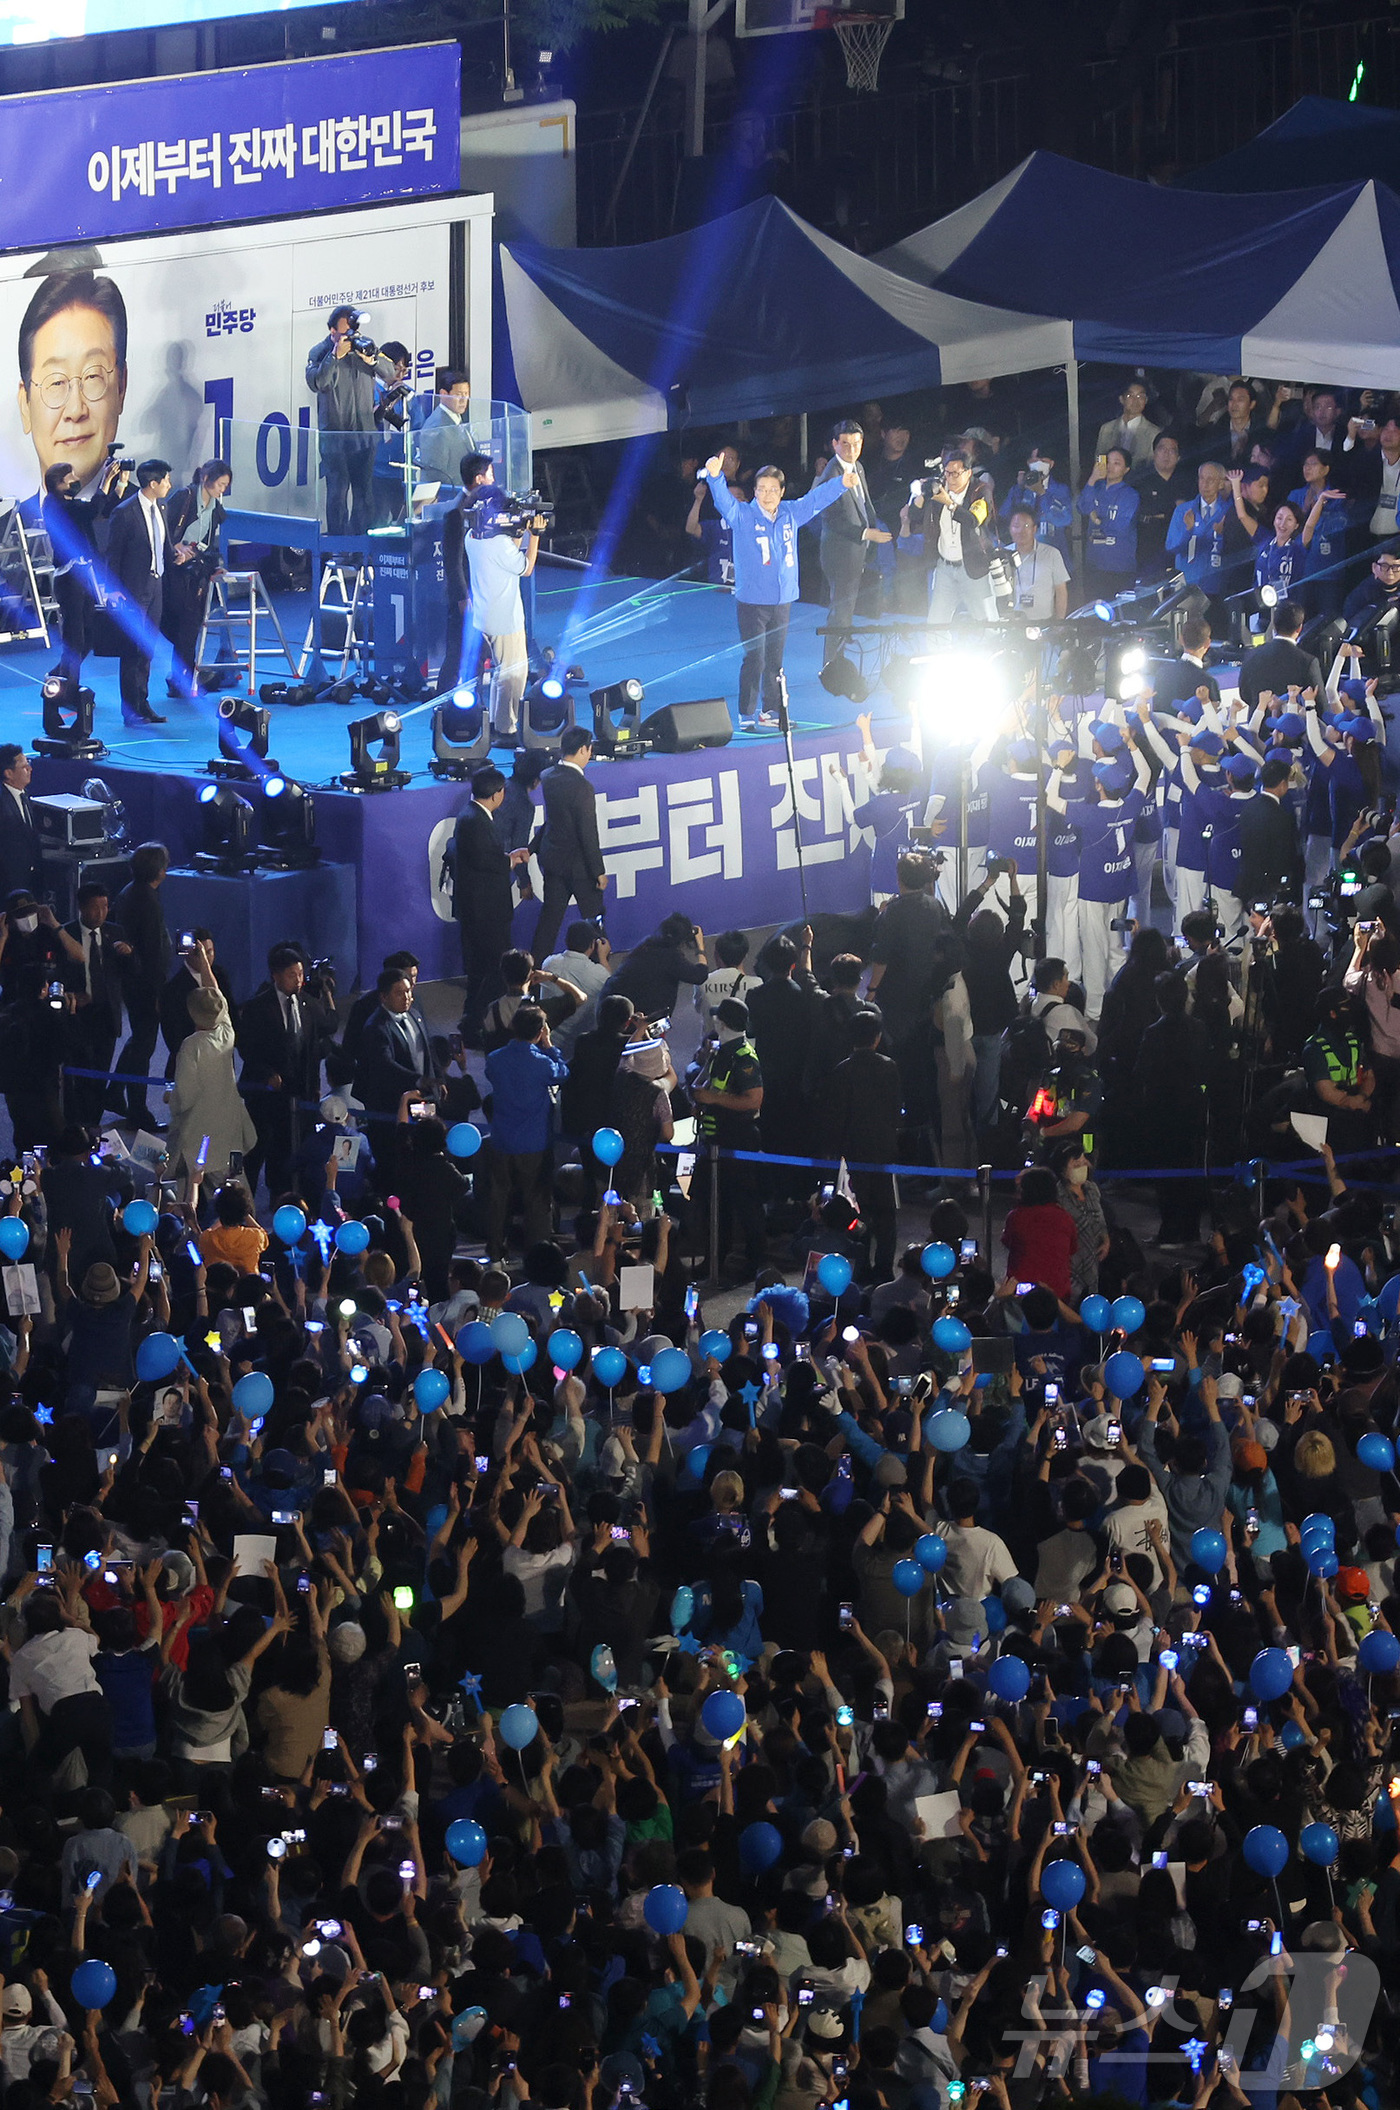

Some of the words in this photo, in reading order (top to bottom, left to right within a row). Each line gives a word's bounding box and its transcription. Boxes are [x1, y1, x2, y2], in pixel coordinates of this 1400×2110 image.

[87, 131, 223, 202] 이제부터
[227, 123, 298, 186] 진짜
[301, 108, 437, 175] 대한민국
[308, 291, 354, 308] 더불어민주당
[355, 287, 380, 302] 제21대
[381, 282, 419, 299] 대통령선거
[420, 280, 435, 293] 후보
[205, 307, 257, 338] 민주당
[755, 536, 770, 566] 1
[390, 593, 405, 644] 1
